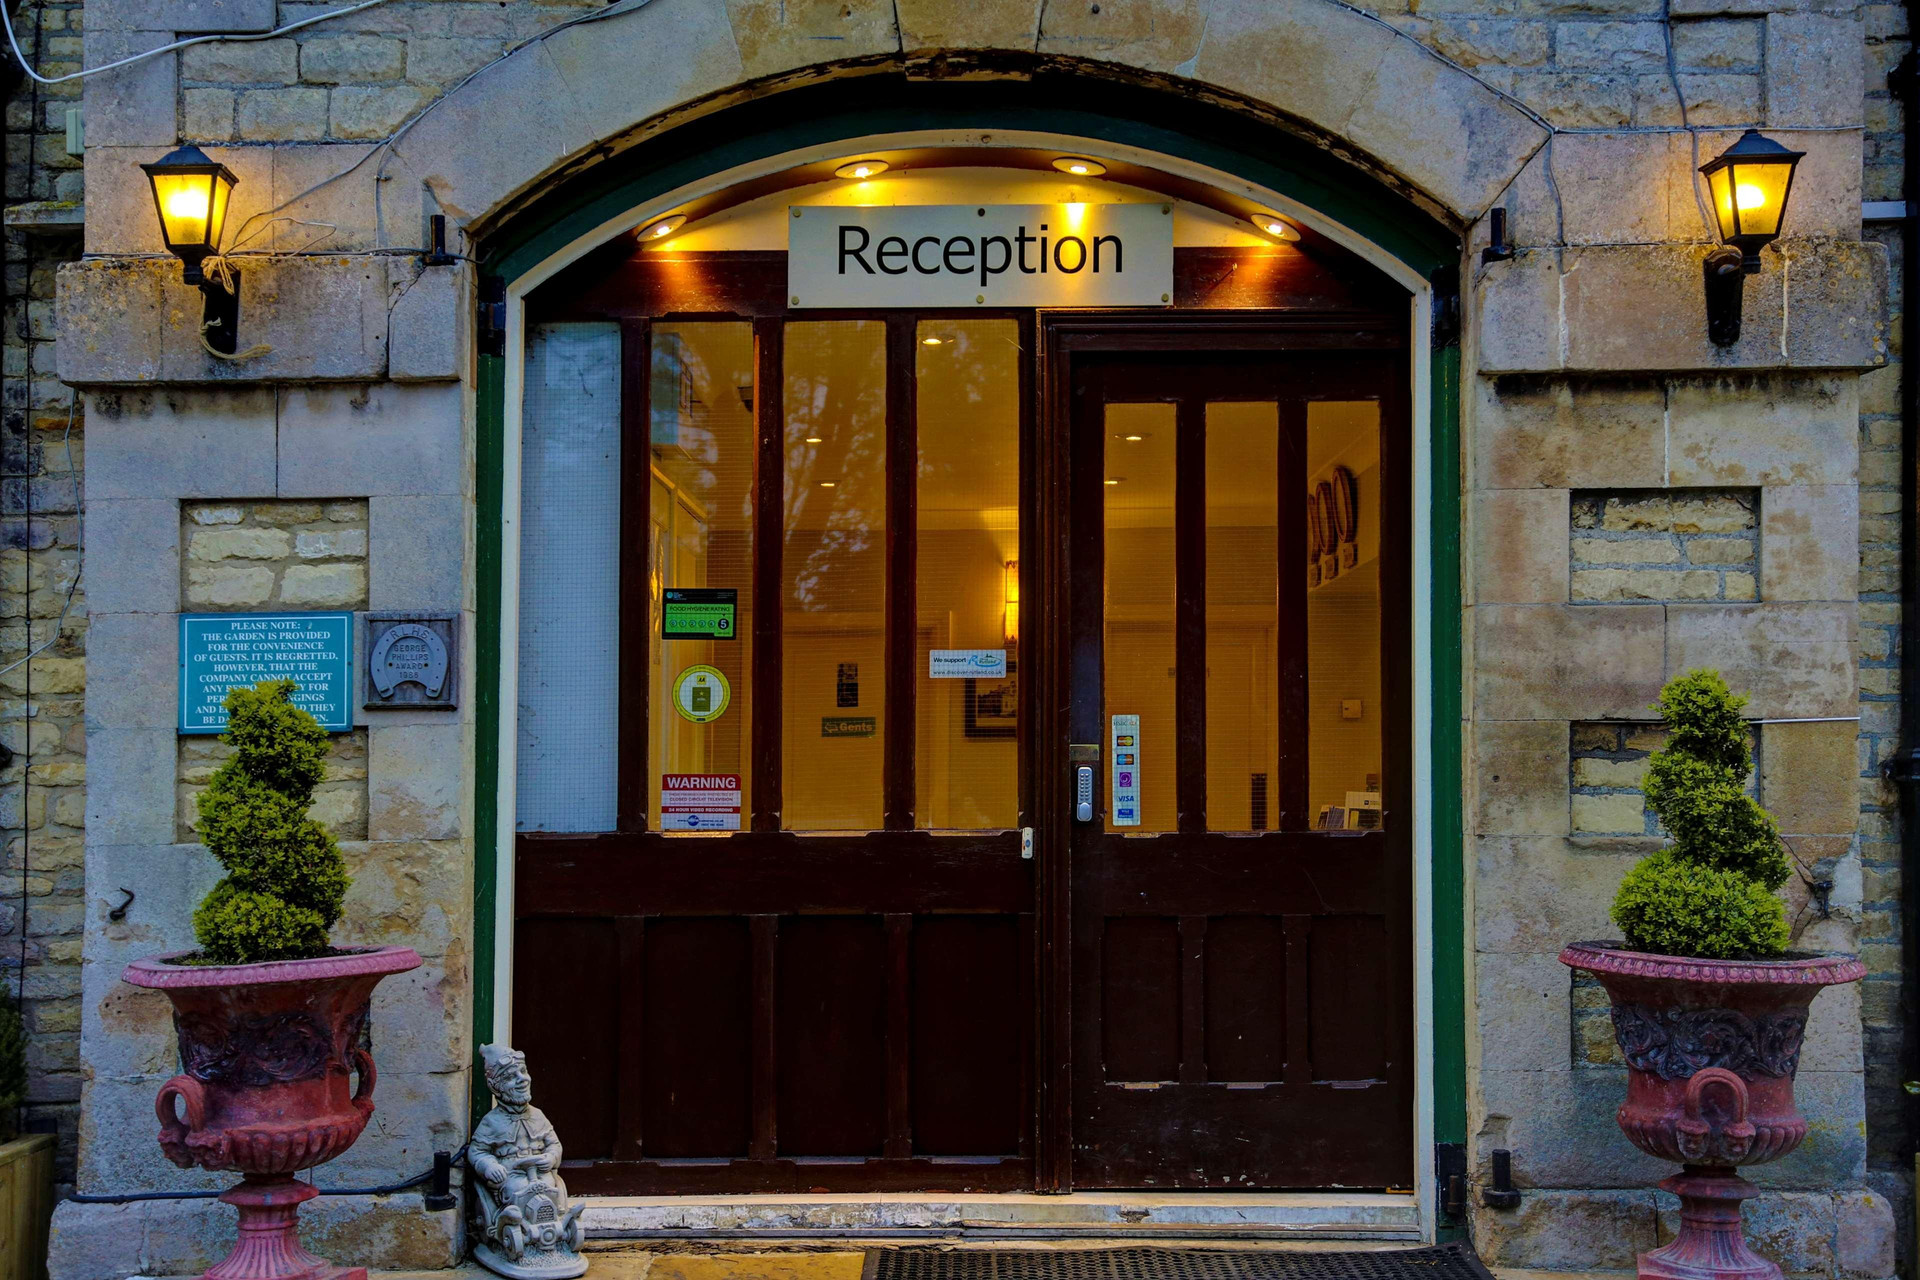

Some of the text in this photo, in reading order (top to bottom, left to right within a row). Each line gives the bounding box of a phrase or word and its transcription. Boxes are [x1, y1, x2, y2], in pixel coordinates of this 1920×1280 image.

[838, 224, 1123, 287] Reception
[231, 621, 300, 630] PLEASE NOTE:
[720, 619, 727, 629] 5
[201, 631, 331, 641] THE GARDEN IS PROVIDED
[208, 641, 324, 651] FOR THE CONVENIENCE
[393, 644, 426, 652] GEORGE
[194, 653, 207, 662] OF
[209, 653, 249, 661] GUESTS.
[251, 653, 262, 661] IT
[264, 652, 274, 660] IS
[214, 662, 318, 672] HOWEVER, THAT THE
[199, 672, 333, 682] COMPANY CANNOT ACCEPT
[203, 685, 223, 693] ANY
[308, 683, 329, 691] FOR
[195, 706, 216, 714] AND
[309, 703, 335, 712] THEY
[203, 716, 215, 724] BE
[840, 723, 873, 731] Gents
[667, 777, 736, 789] WARNING
